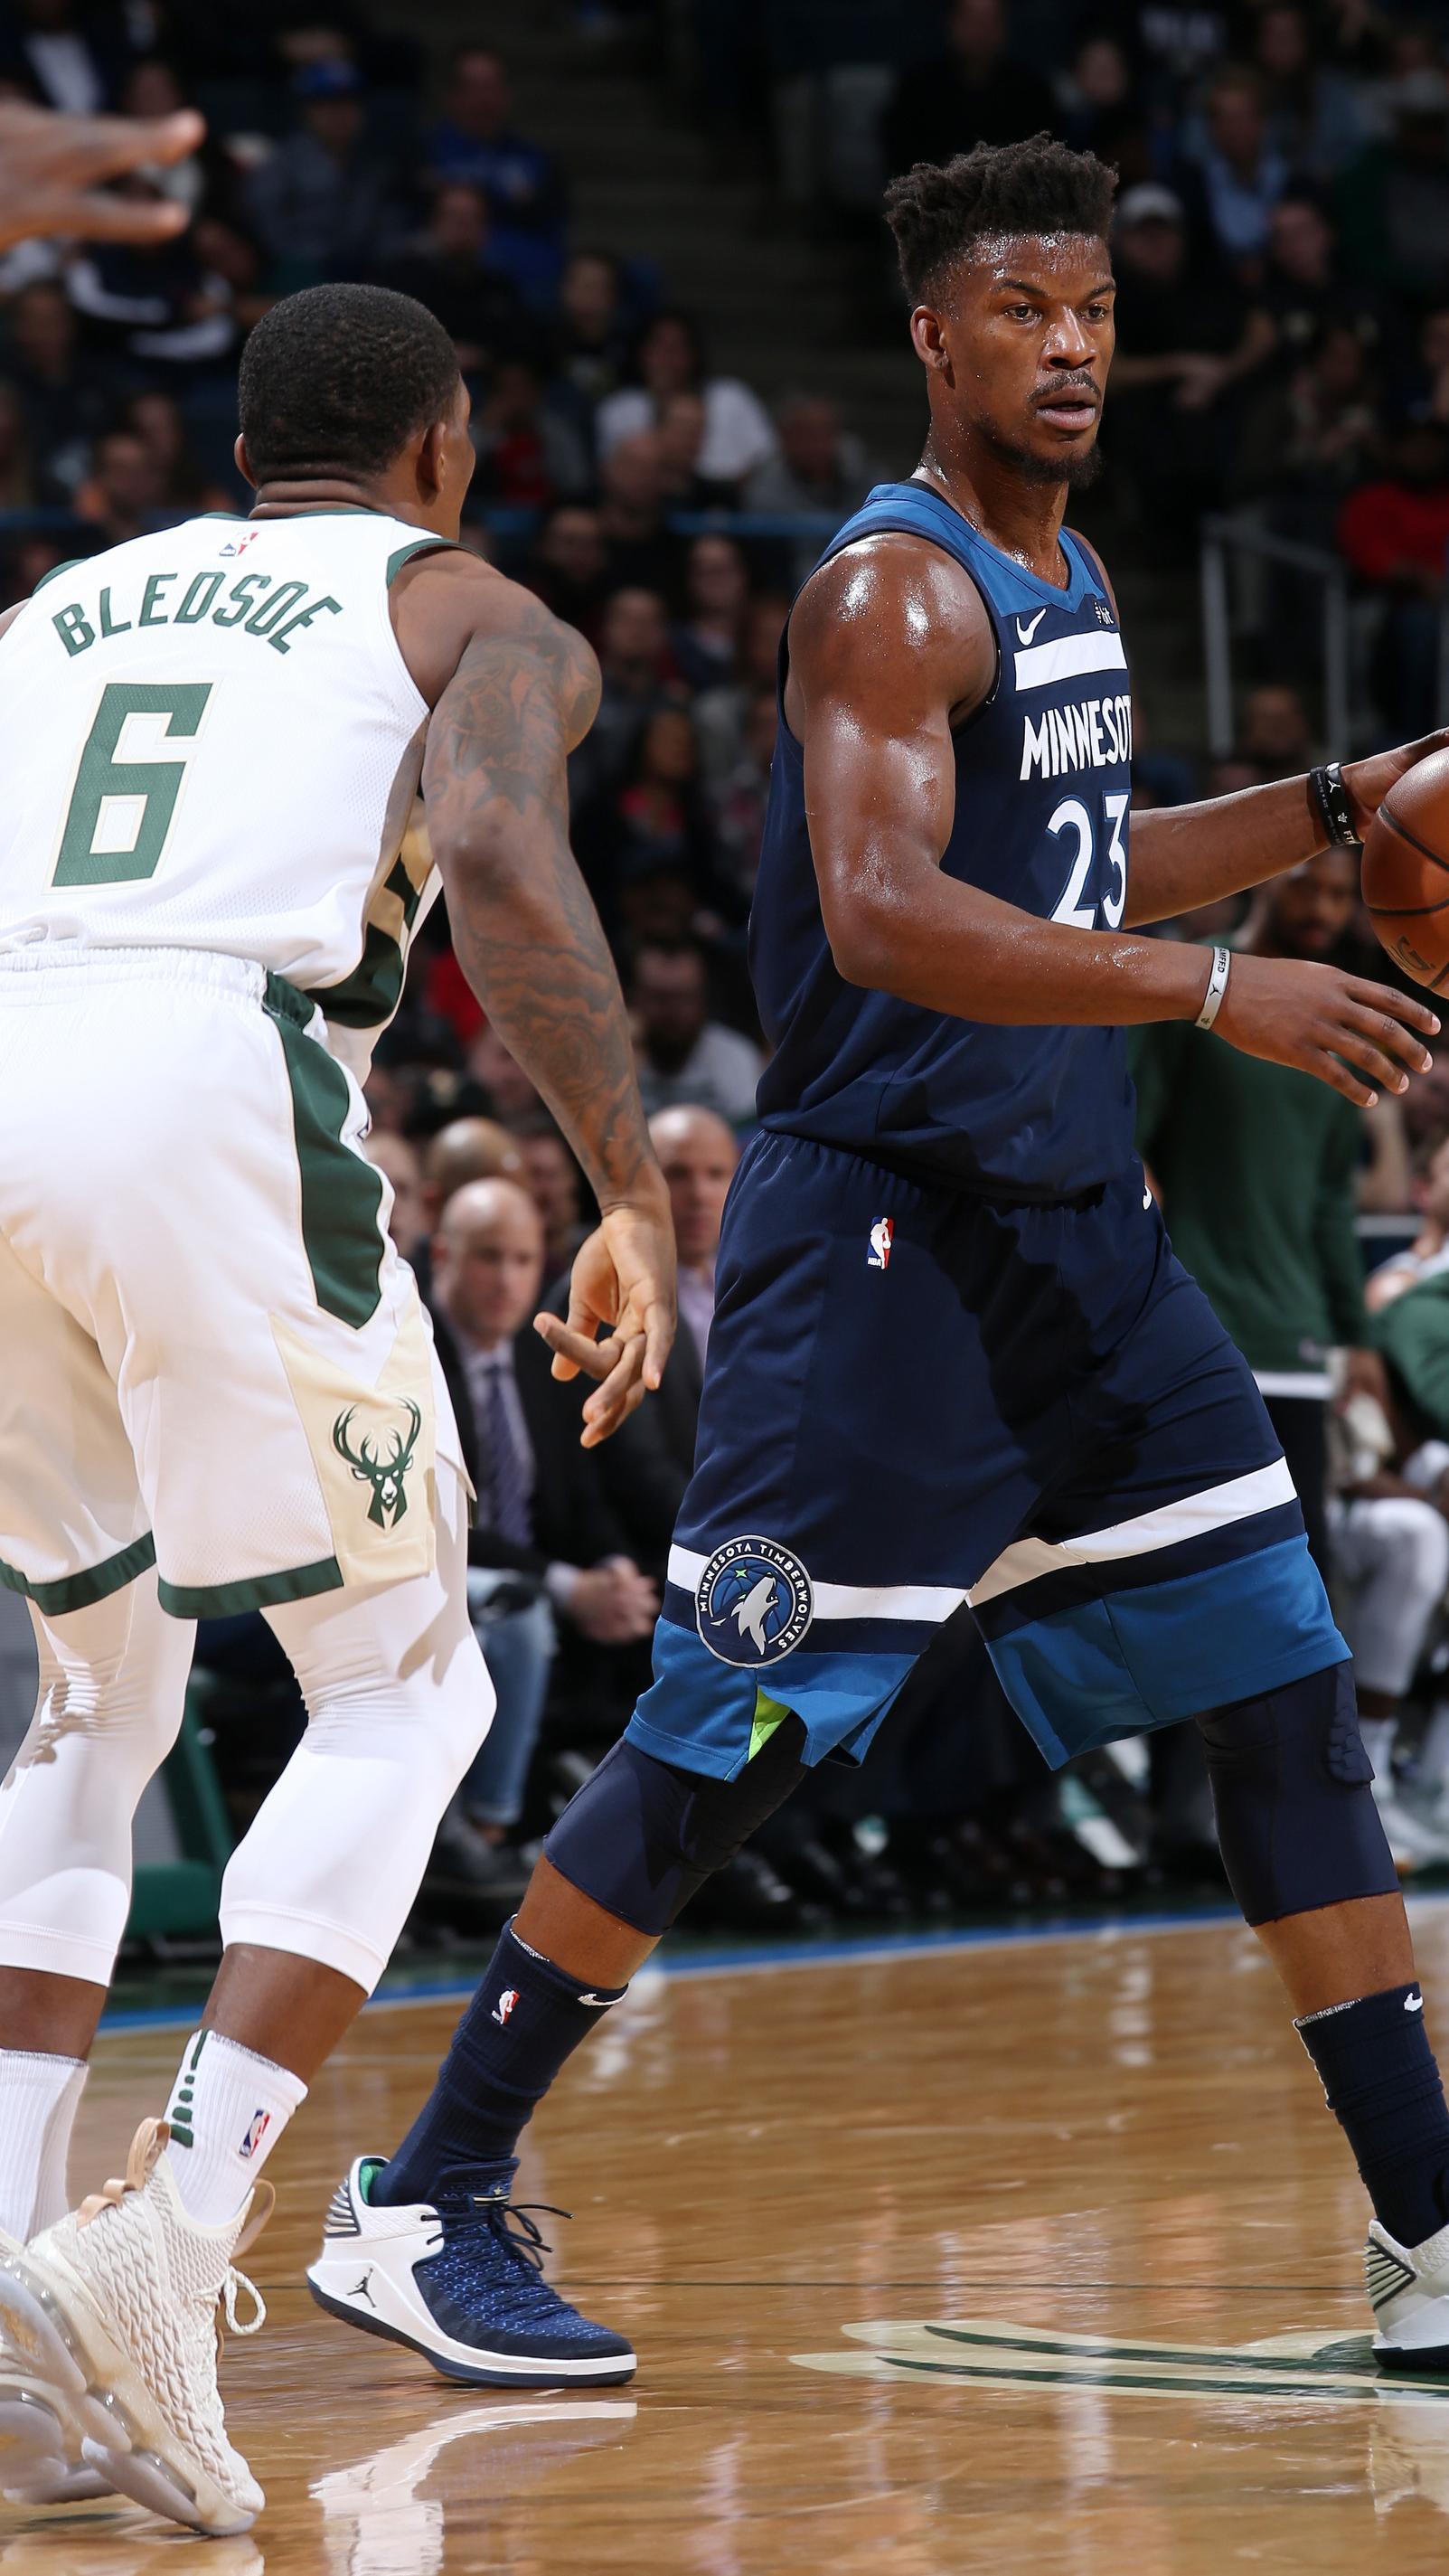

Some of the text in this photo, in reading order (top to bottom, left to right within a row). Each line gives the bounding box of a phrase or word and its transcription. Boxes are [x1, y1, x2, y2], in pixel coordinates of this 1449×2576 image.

[52, 571, 343, 656] BLEDSOE
[50, 682, 215, 889] 6
[1046, 789, 1131, 931] 23
[867, 1257, 881, 1267] NBA
[700, 1543, 809, 1649] MINNESOTA TIMBERWOLVES
